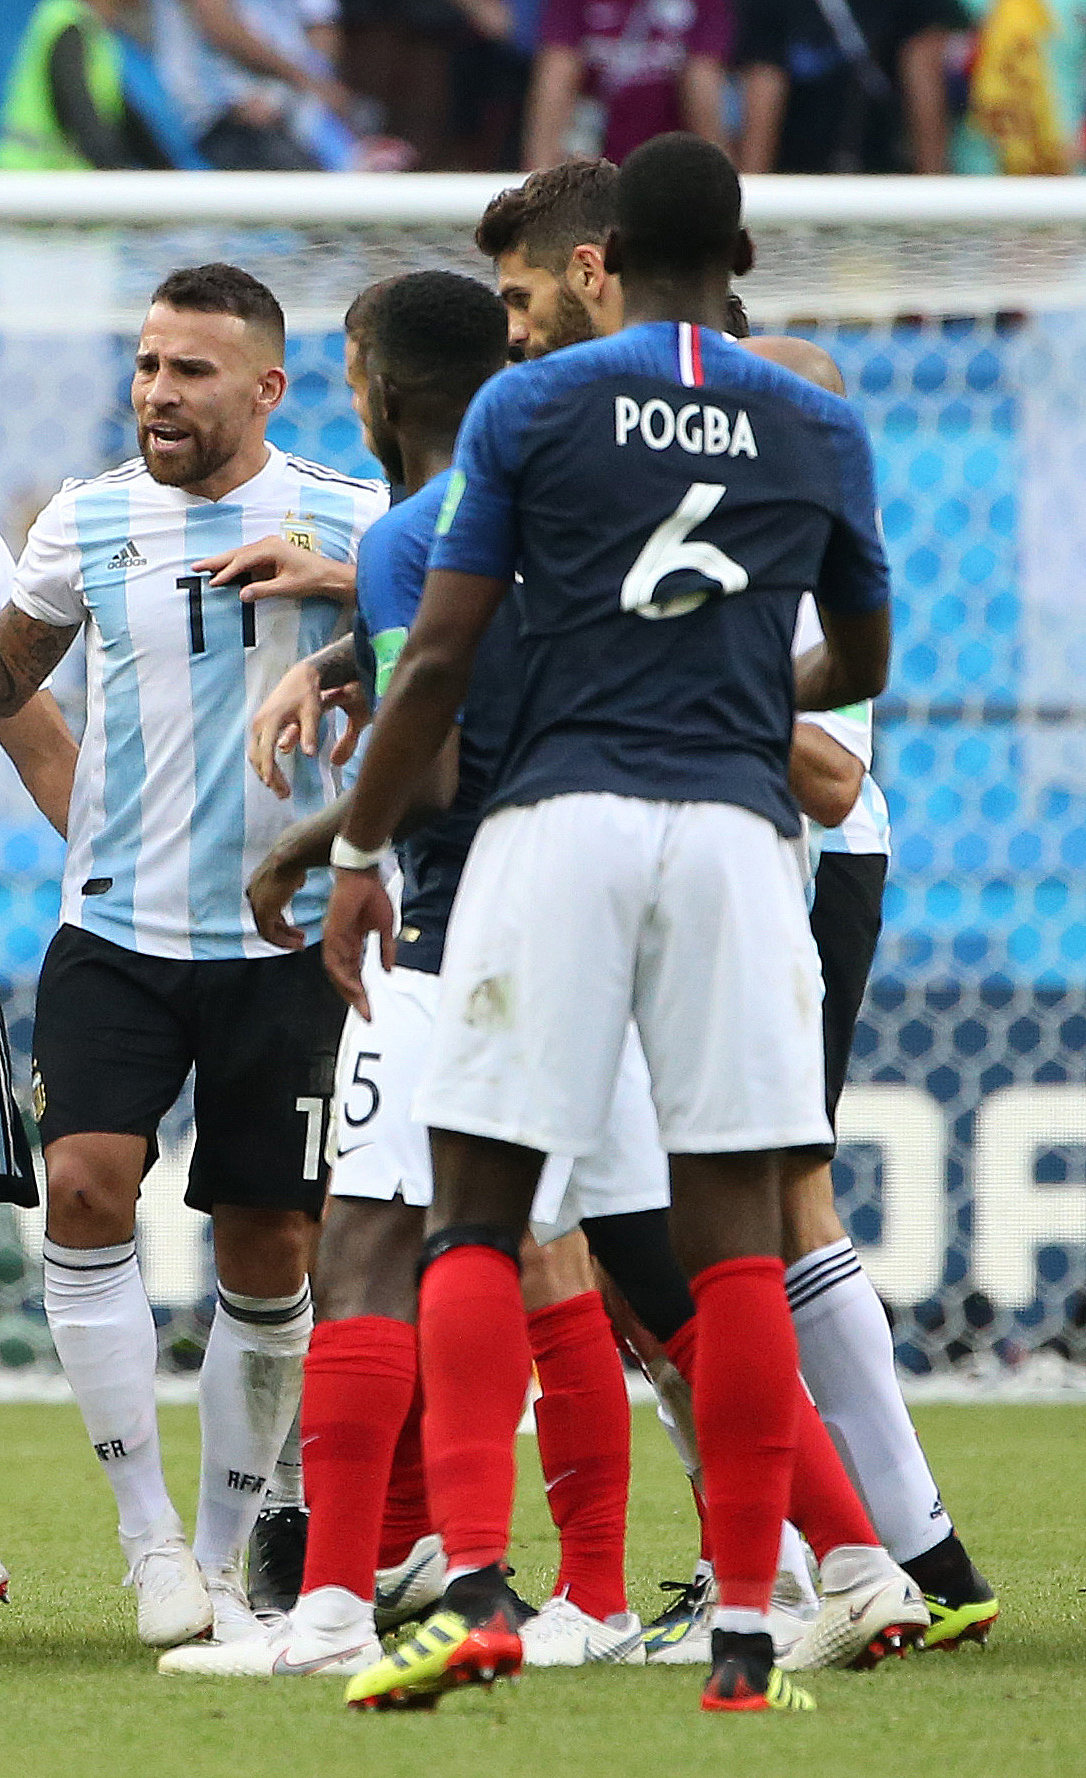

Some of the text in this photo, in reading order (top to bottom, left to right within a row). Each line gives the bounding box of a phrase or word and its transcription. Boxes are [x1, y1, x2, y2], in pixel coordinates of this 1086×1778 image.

[614, 395, 758, 459] POGBA
[107, 558, 147, 569] adidas
[620, 482, 749, 620] 6
[343, 1051, 382, 1127] 5
[295, 1097, 324, 1181] 1
